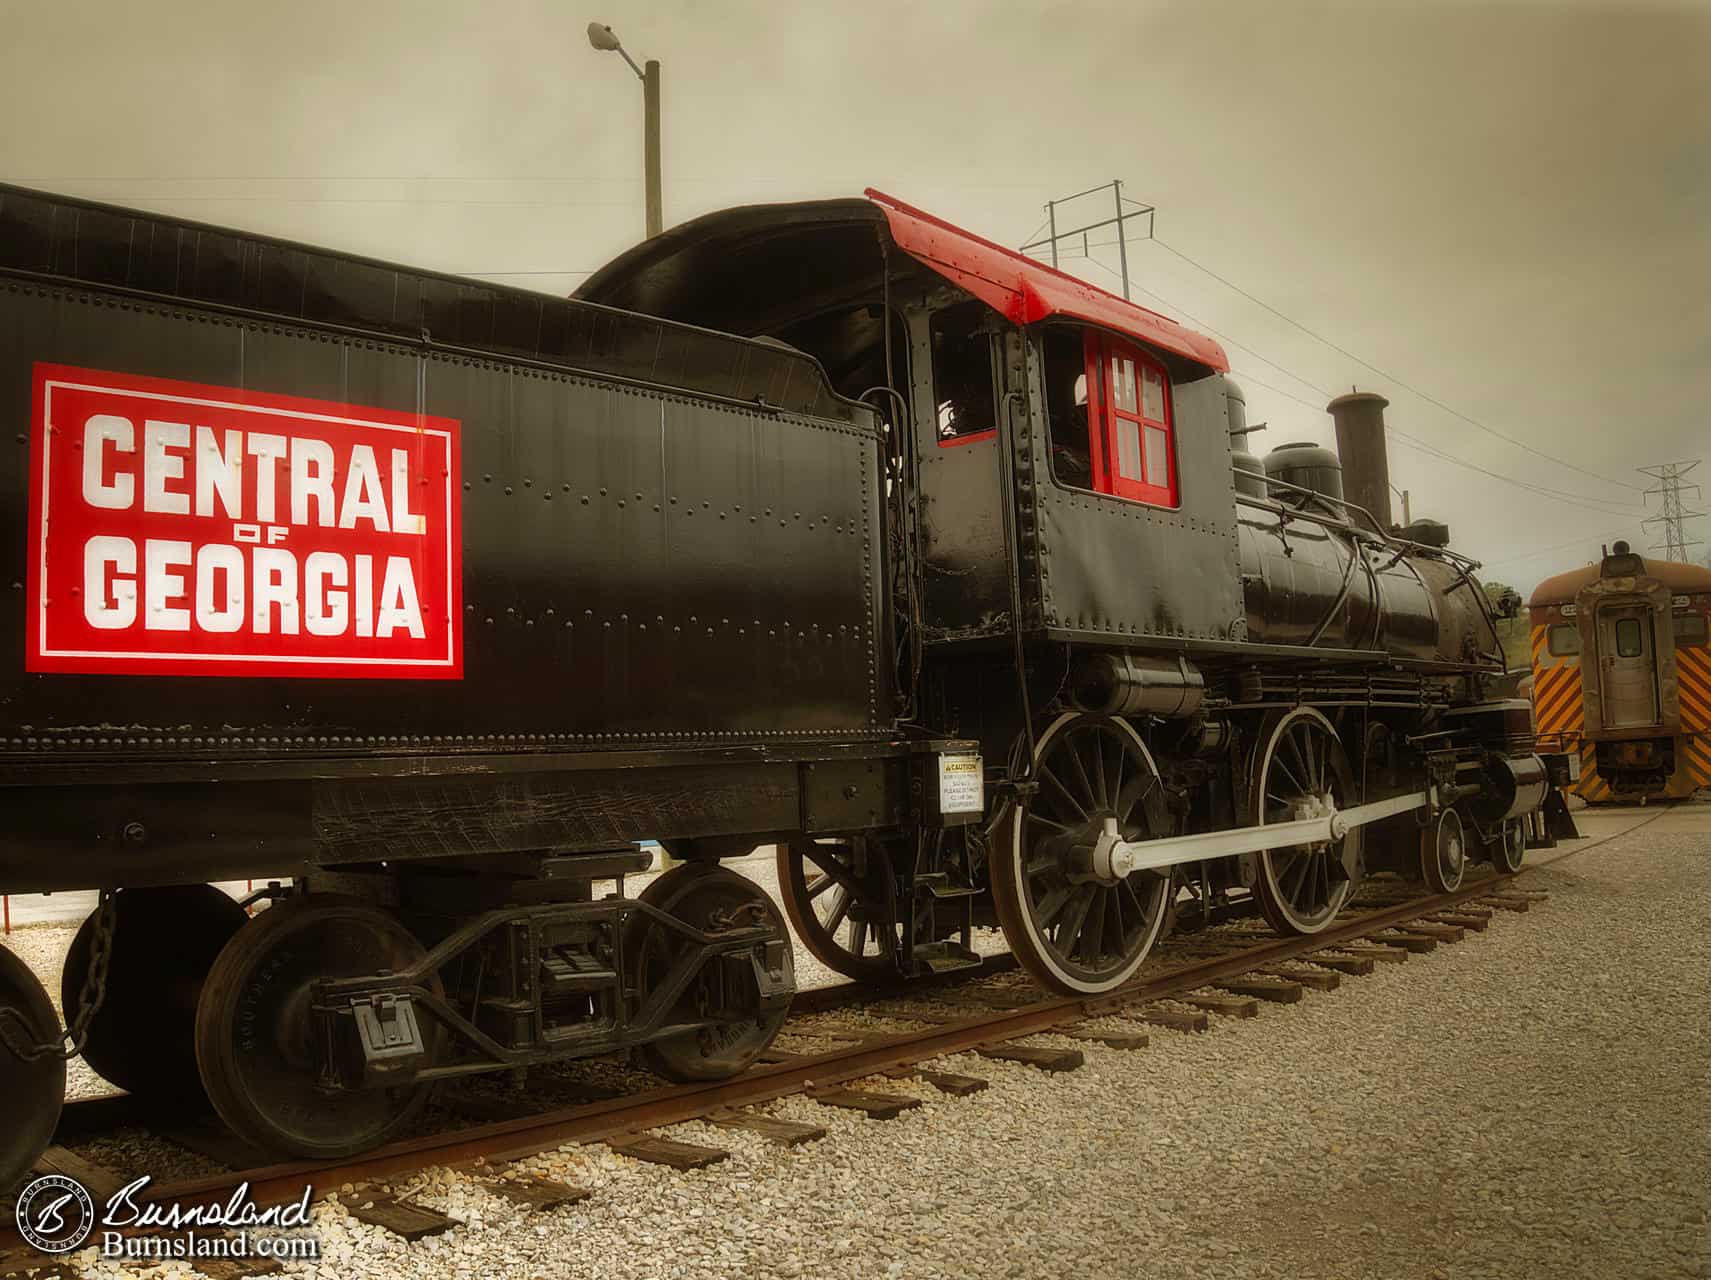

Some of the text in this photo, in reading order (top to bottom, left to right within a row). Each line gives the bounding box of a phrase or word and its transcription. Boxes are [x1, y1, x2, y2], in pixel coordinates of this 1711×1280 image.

[82, 414, 426, 535] CENTRAL
[233, 523, 289, 545] OF
[83, 535, 426, 639] GEORGIA
[951, 763, 977, 771] CAUTION
